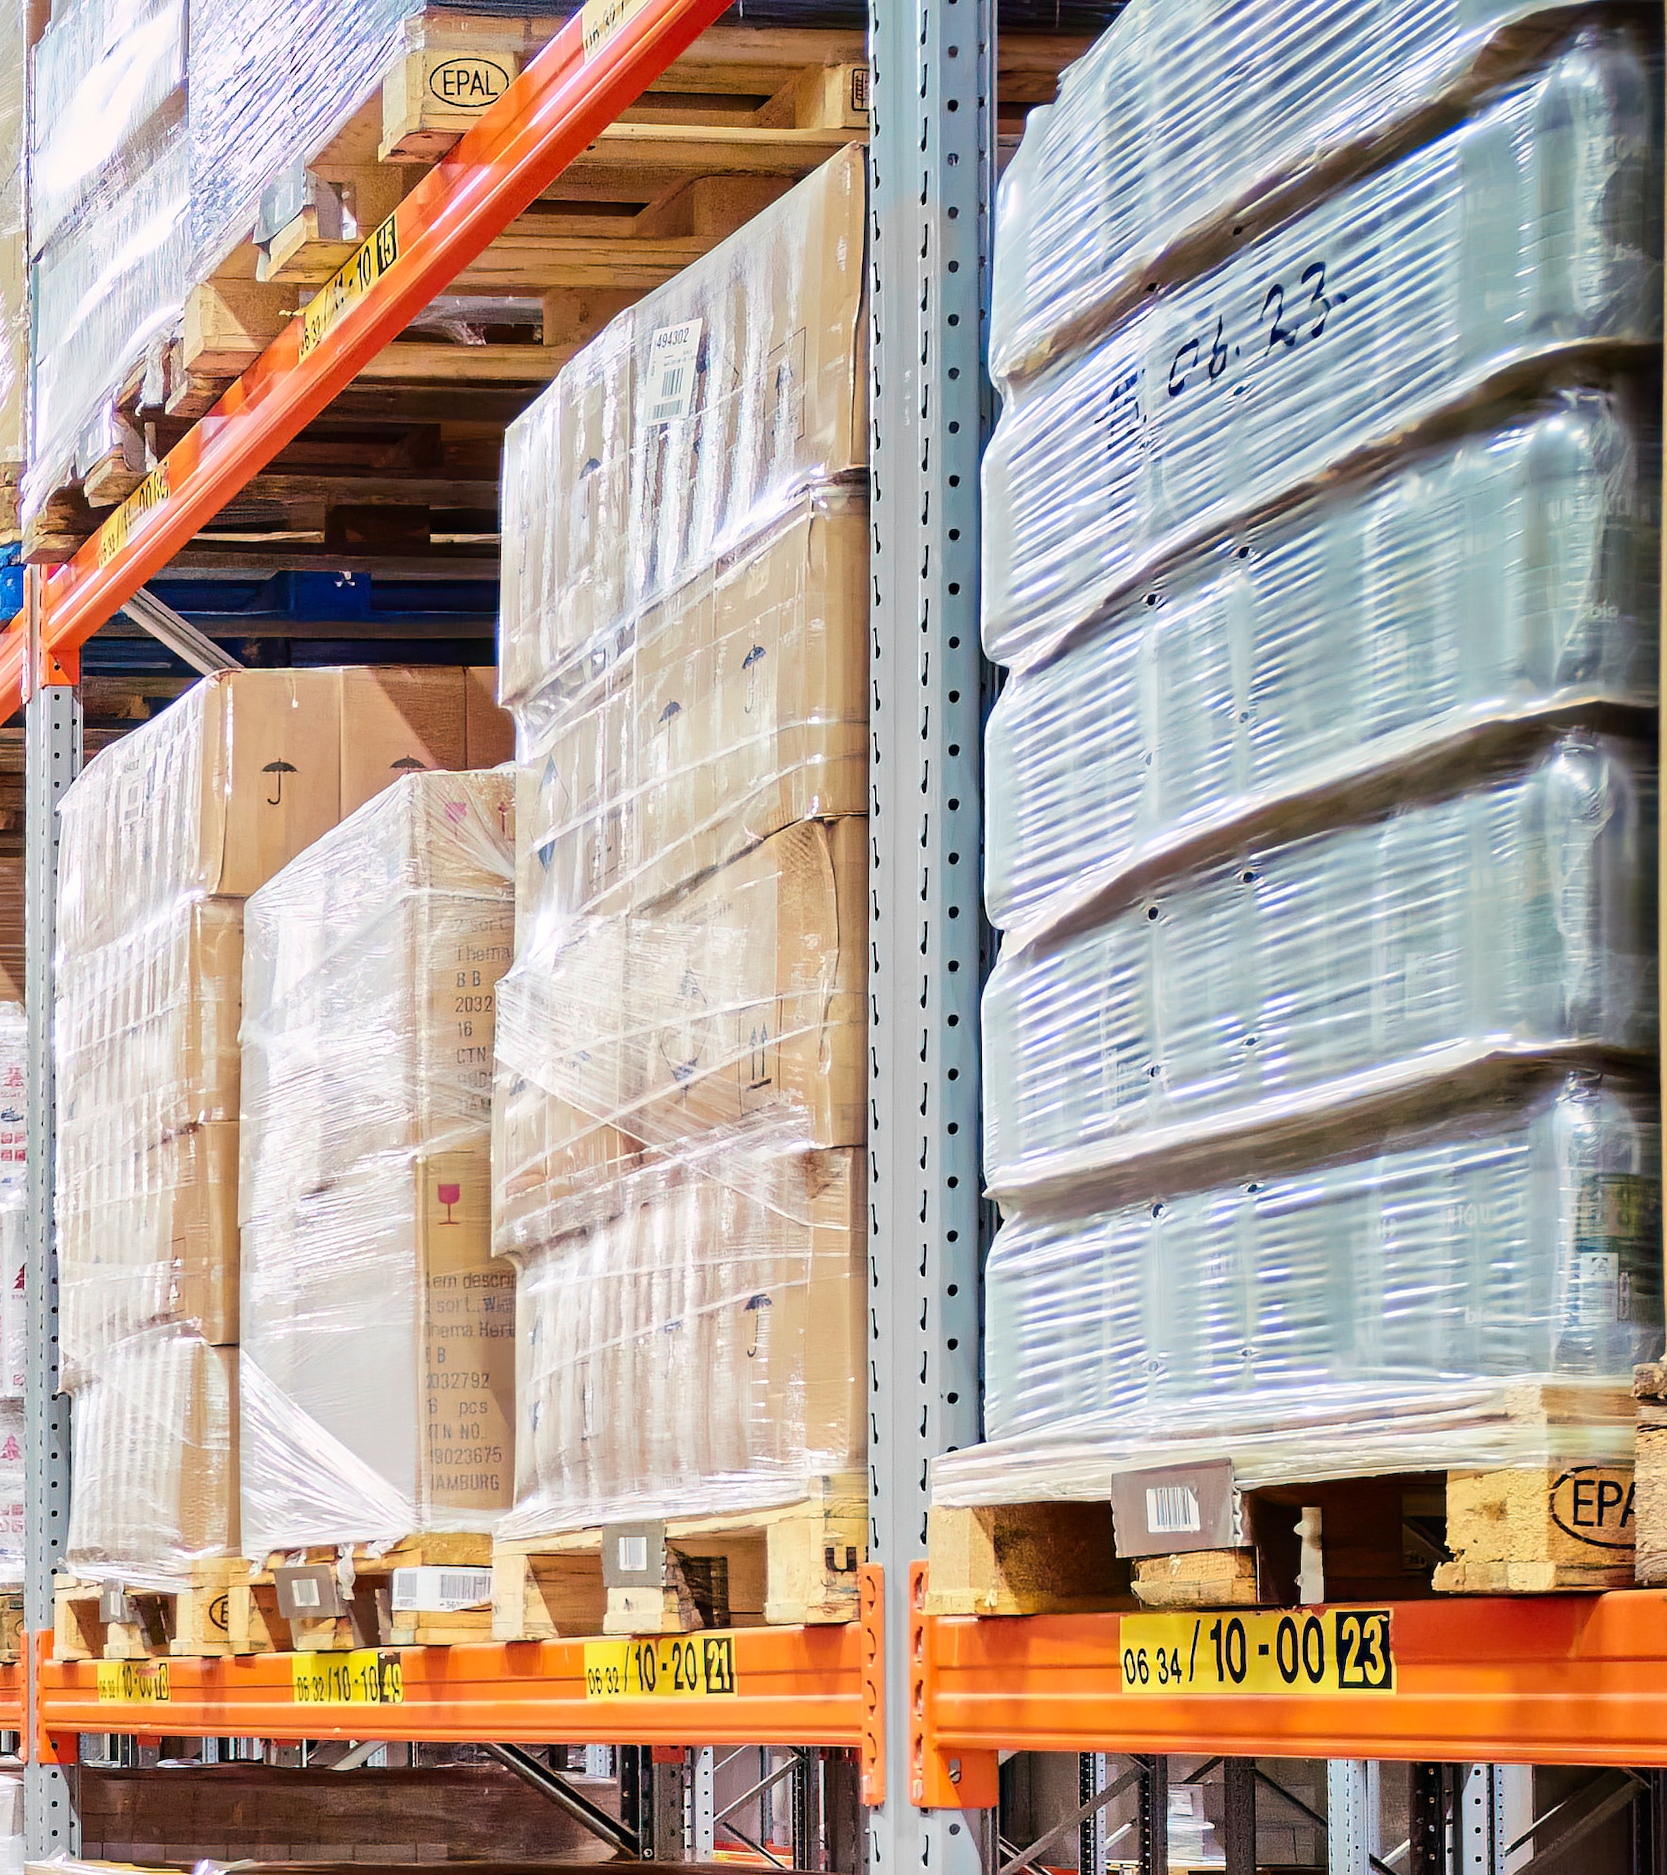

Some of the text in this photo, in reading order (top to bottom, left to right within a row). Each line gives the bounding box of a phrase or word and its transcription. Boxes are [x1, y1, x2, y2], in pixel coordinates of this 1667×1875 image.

[443, 70, 499, 96] EPAL
[656, 327, 689, 350] 494302
[455, 995, 494, 1013] 2032
[457, 1047, 487, 1064] CTN
[459, 1400, 488, 1418] pcs
[1123, 1647, 1149, 1686] 06
[1156, 1646, 1182, 1684] 34
[1338, 1613, 1388, 1688] 23
[587, 1668, 603, 1694] 06
[607, 1666, 620, 1693] 32
[706, 1640, 732, 1693] 21
